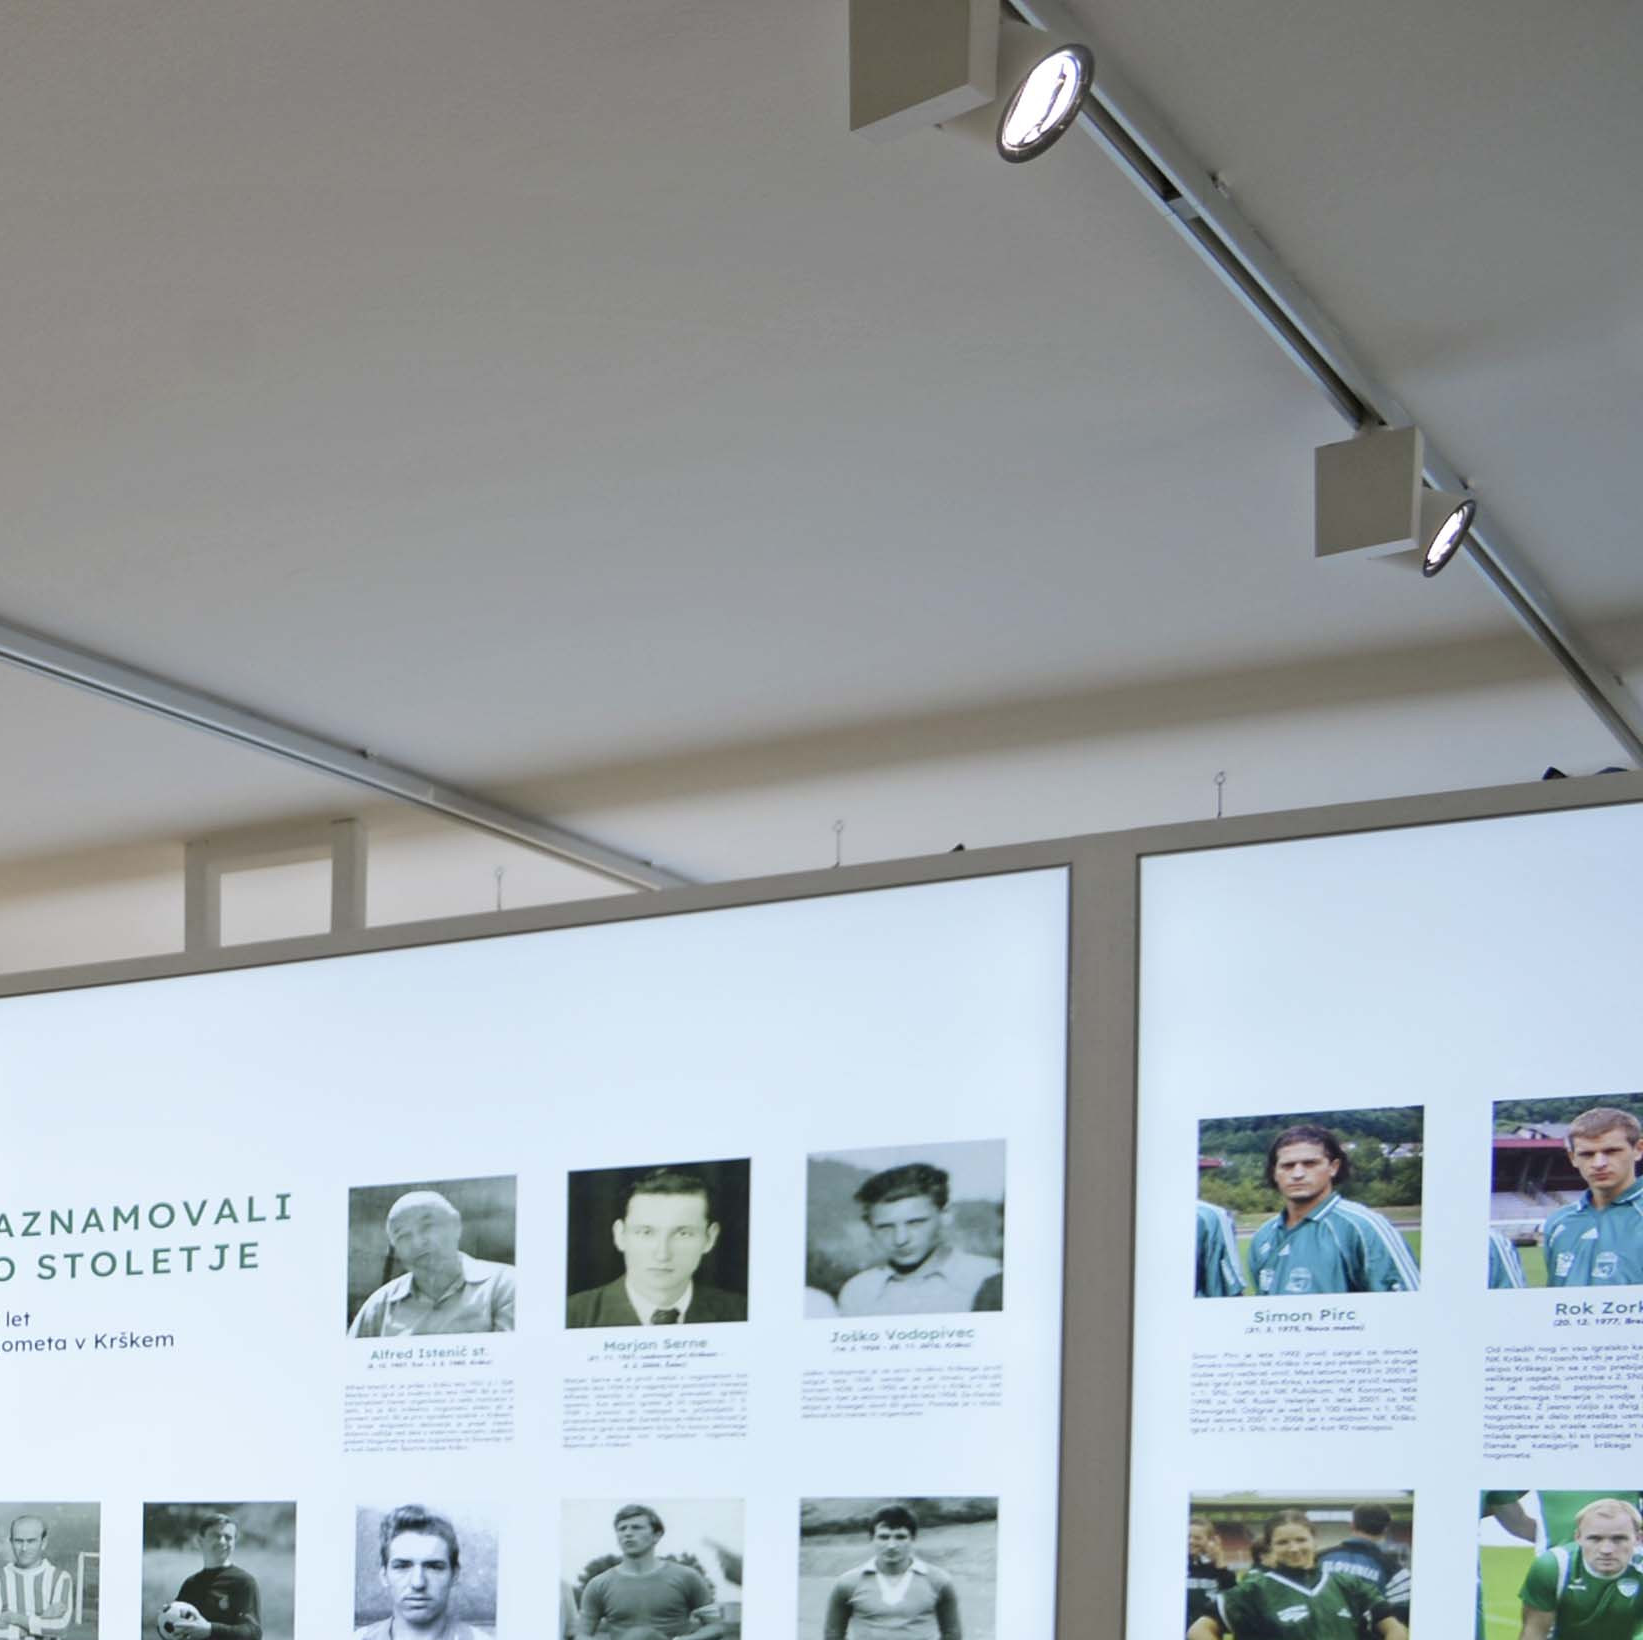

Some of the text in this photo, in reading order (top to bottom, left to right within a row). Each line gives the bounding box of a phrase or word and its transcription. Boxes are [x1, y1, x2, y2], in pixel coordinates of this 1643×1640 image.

[36, 1241, 259, 1280] STOLETJE
[1253, 1308, 1355, 1324] Simon Pirc
[1554, 1300, 1593, 1316] Rok
[5, 1310, 30, 1328] let
[74, 1337, 86, 1350] v
[93, 1330, 174, 1350] Krškem
[829, 1327, 975, 1343] Joško Vodopivec
[369, 1347, 413, 1360] Alfred
[471, 1346, 488, 1357] st.
[602, 1337, 708, 1353] Marjan Serne
